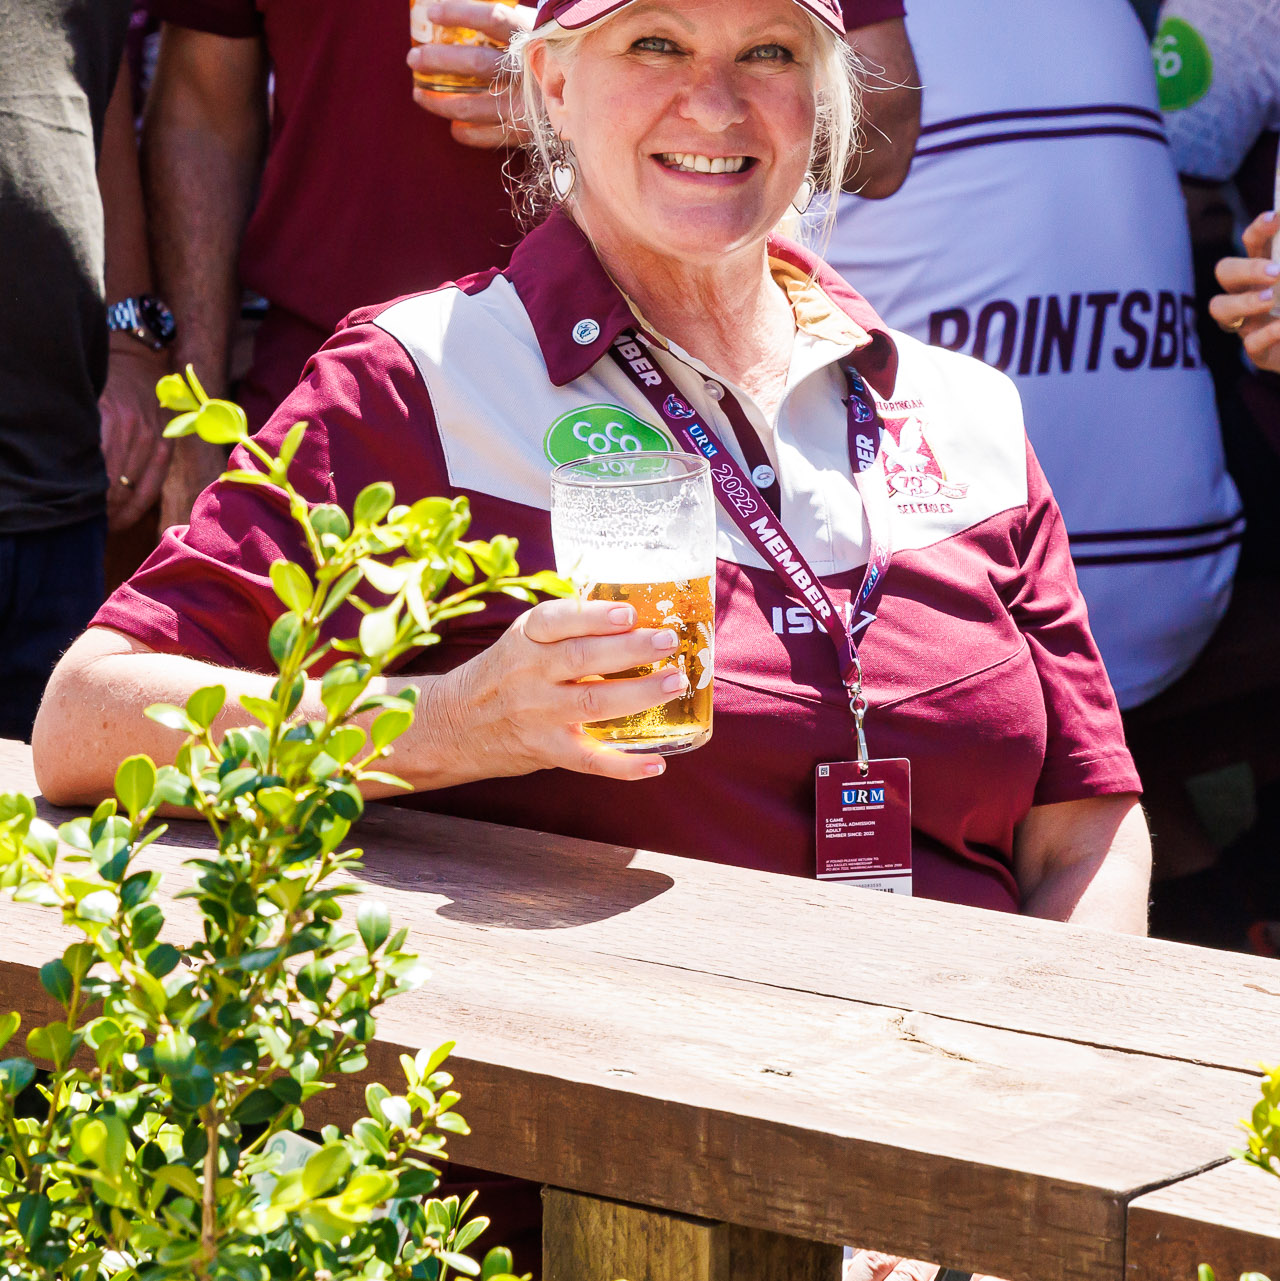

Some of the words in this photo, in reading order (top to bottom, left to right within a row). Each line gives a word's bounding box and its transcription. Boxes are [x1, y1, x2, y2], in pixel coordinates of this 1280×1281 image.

[573, 421, 643, 453] COCO
[688, 423, 718, 458] URM
[598, 461, 636, 477] JOY
[711, 463, 759, 518] 2022
[749, 515, 832, 620] MEMBER
[863, 563, 879, 599] URM
[842, 789, 884, 803] URM
